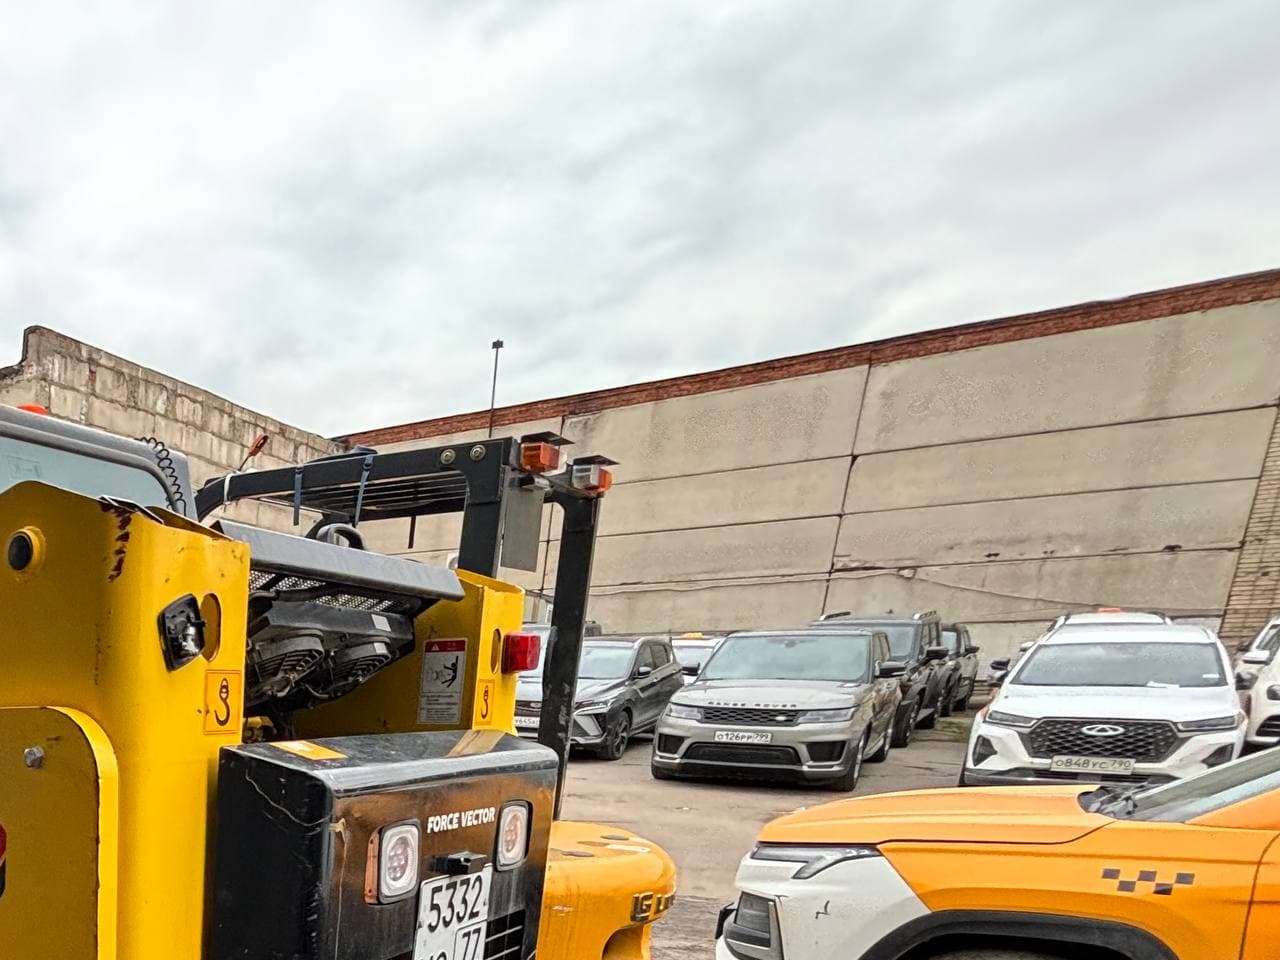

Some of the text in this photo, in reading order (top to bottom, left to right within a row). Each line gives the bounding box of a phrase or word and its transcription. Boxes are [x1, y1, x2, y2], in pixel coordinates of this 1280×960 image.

[427, 807, 496, 834] FORCE VECTOR
[428, 874, 483, 933] 5332
